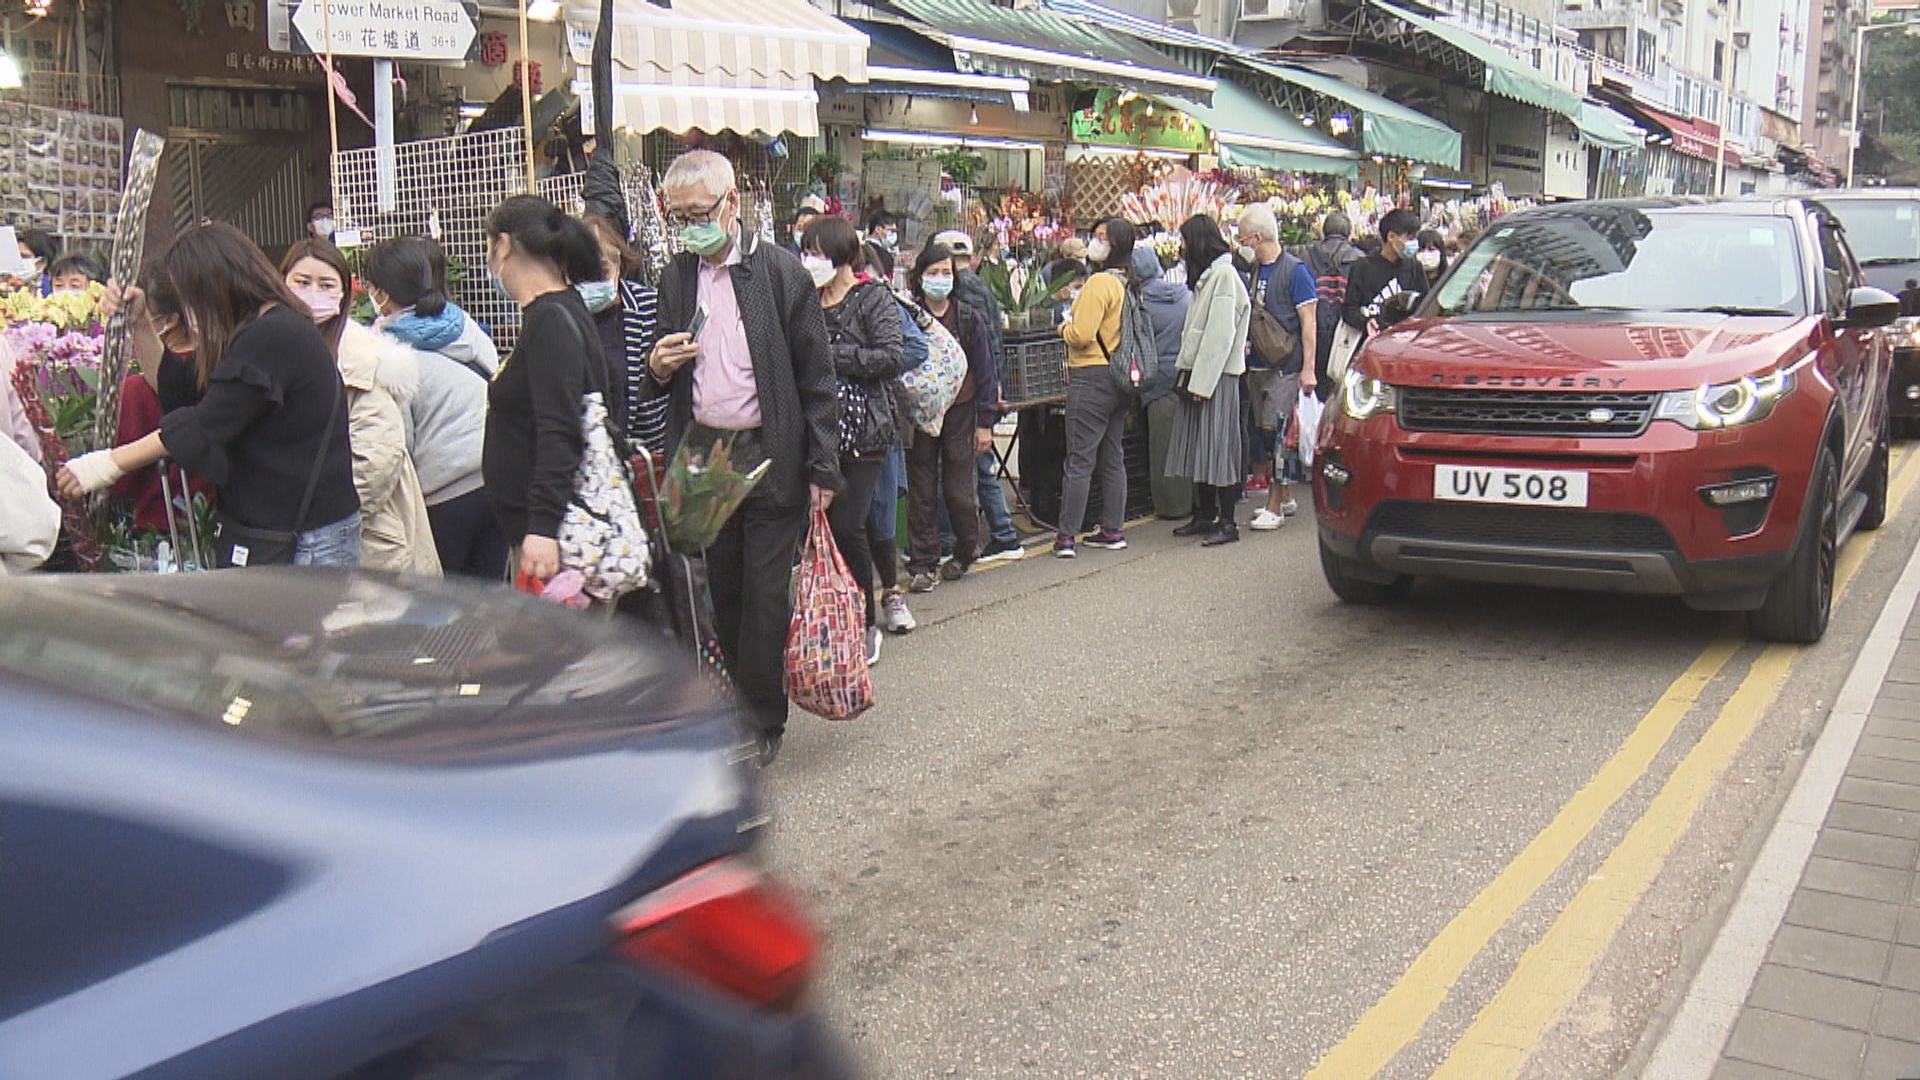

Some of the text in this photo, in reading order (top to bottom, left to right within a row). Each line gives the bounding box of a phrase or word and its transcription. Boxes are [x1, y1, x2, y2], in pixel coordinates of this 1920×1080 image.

[313, 2, 458, 24] Fower Market Road
[361, 29, 420, 50] 花墟道
[1430, 374, 1626, 388] DISCOVERY
[1453, 470, 1568, 501] UV 508
